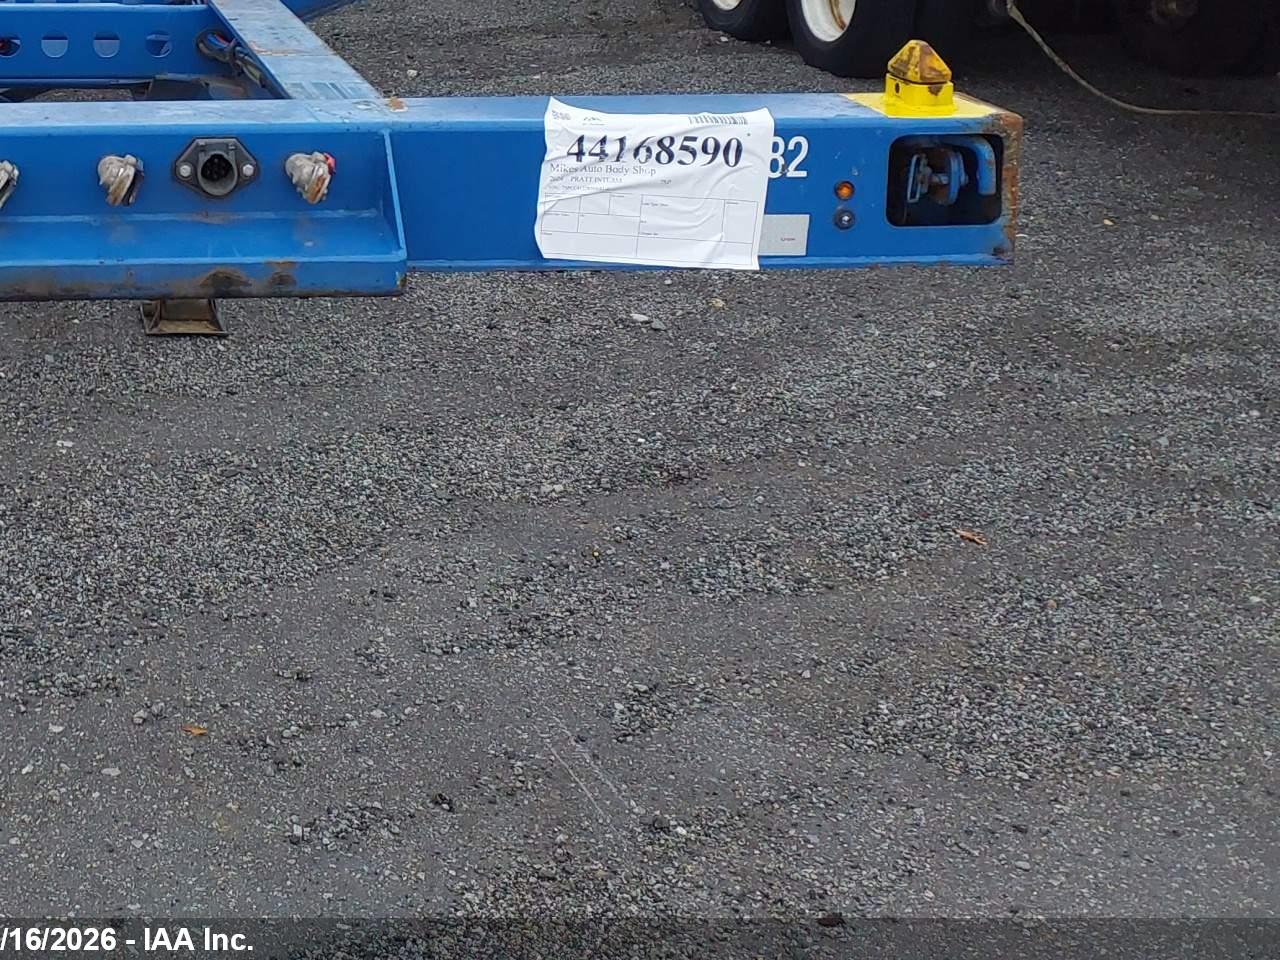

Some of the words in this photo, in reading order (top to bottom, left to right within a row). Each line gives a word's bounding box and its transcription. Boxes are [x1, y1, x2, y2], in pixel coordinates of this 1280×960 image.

[567, 134, 743, 168] 44168590
[768, 136, 809, 178] 82
[580, 165, 602, 173] Auto
[605, 165, 629, 176] Body
